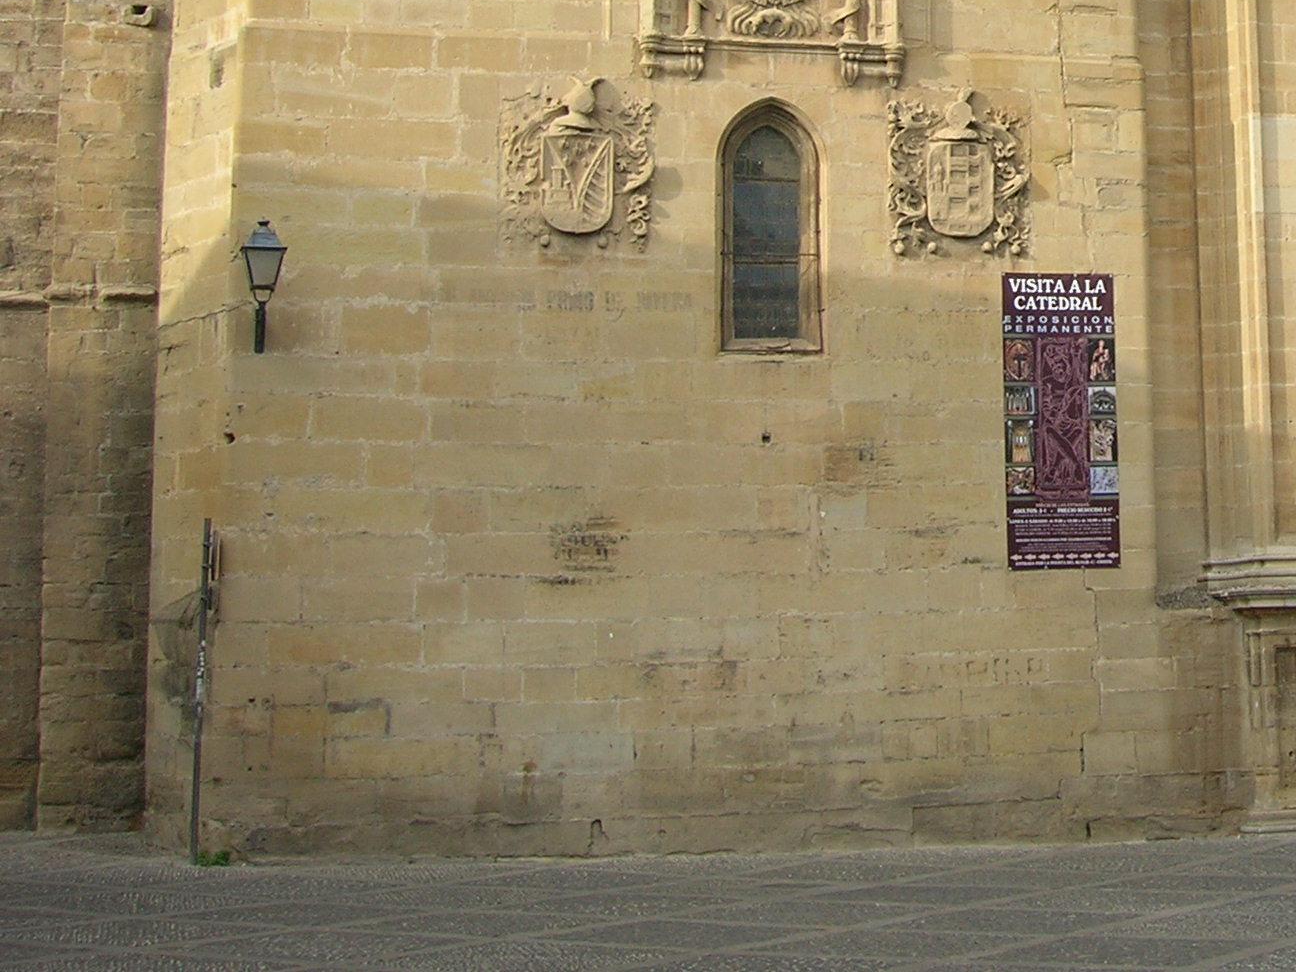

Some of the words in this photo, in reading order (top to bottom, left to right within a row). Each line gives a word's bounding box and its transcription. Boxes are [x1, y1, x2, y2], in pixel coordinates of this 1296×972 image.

[1008, 278, 1065, 293] VISITA
[1069, 279, 1081, 293] A
[1085, 279, 1106, 293] LA
[1014, 295, 1102, 310] CATEDRAL
[1003, 315, 1113, 324] EXPOSICION
[1004, 325, 1112, 333] PERMANENTE
